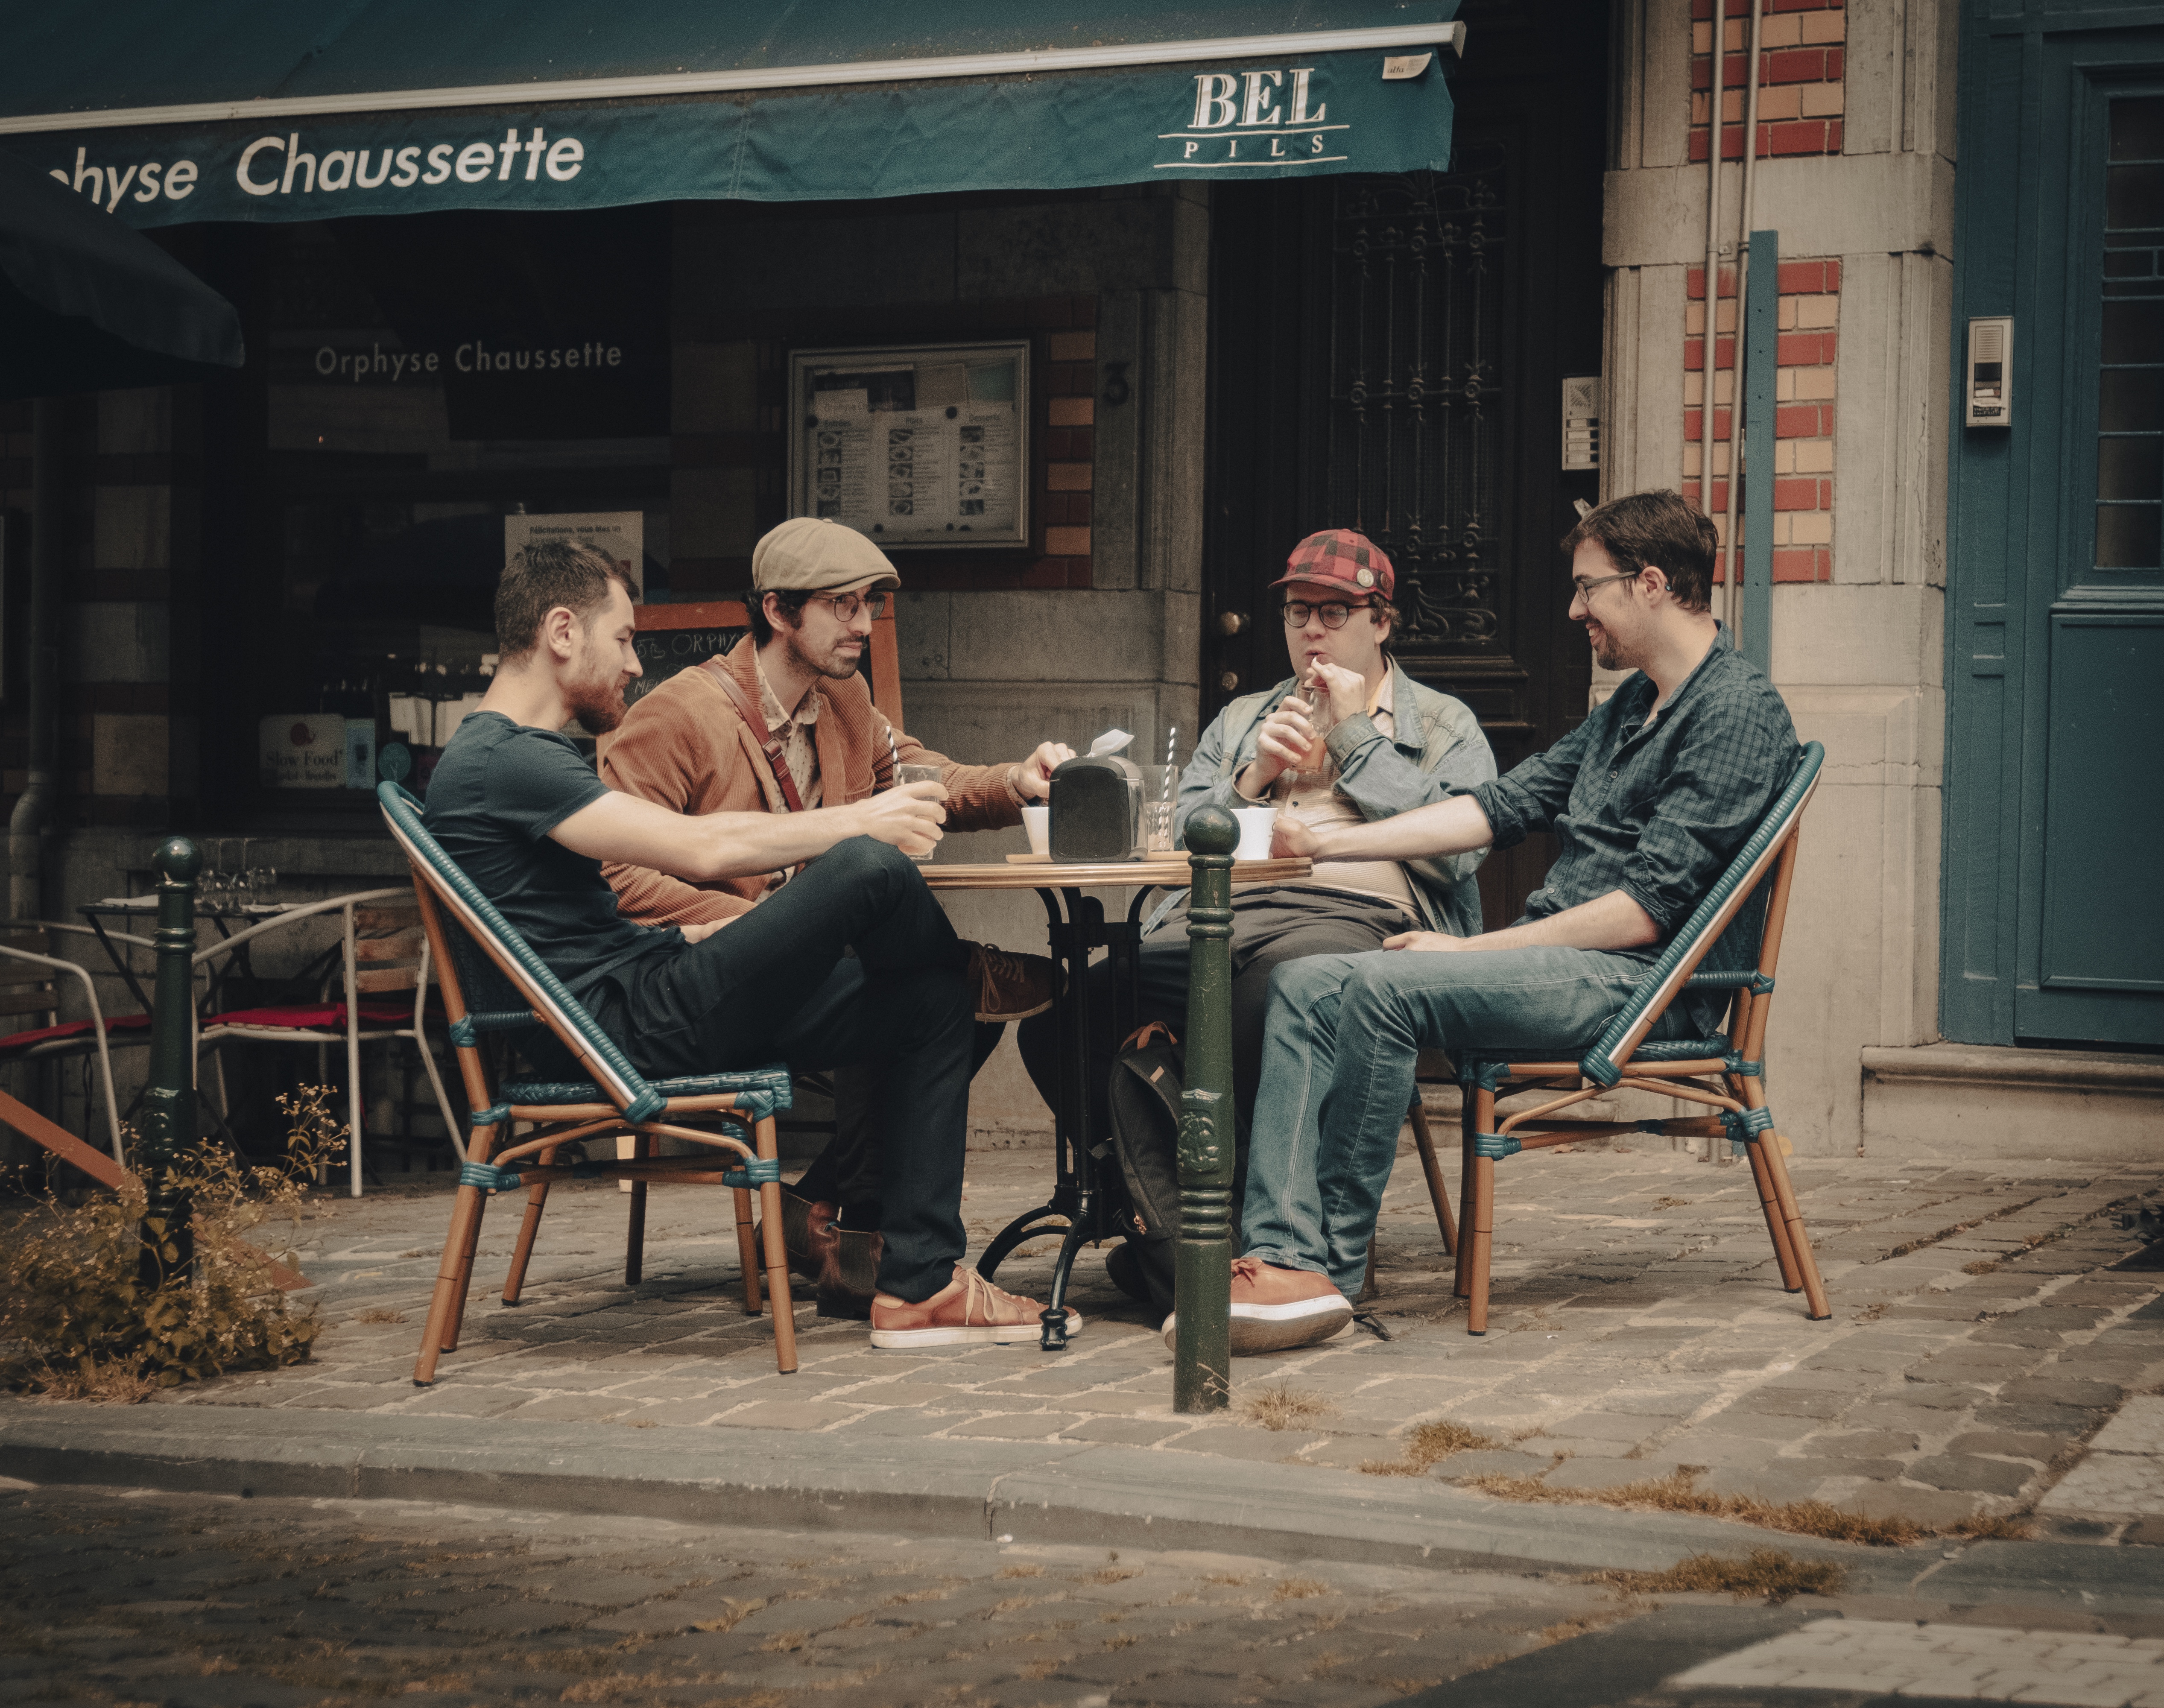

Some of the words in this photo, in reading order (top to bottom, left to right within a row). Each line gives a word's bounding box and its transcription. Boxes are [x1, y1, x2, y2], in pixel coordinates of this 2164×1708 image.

[1187, 67, 1326, 129] BEL
[50, 146, 198, 214] hyse
[237, 128, 585, 195] Chaussette
[315, 342, 440, 383] Orphyse
[455, 340, 622, 373] Chaussette
[1102, 362, 1129, 407] 3
[266, 750, 297, 767] Slow
